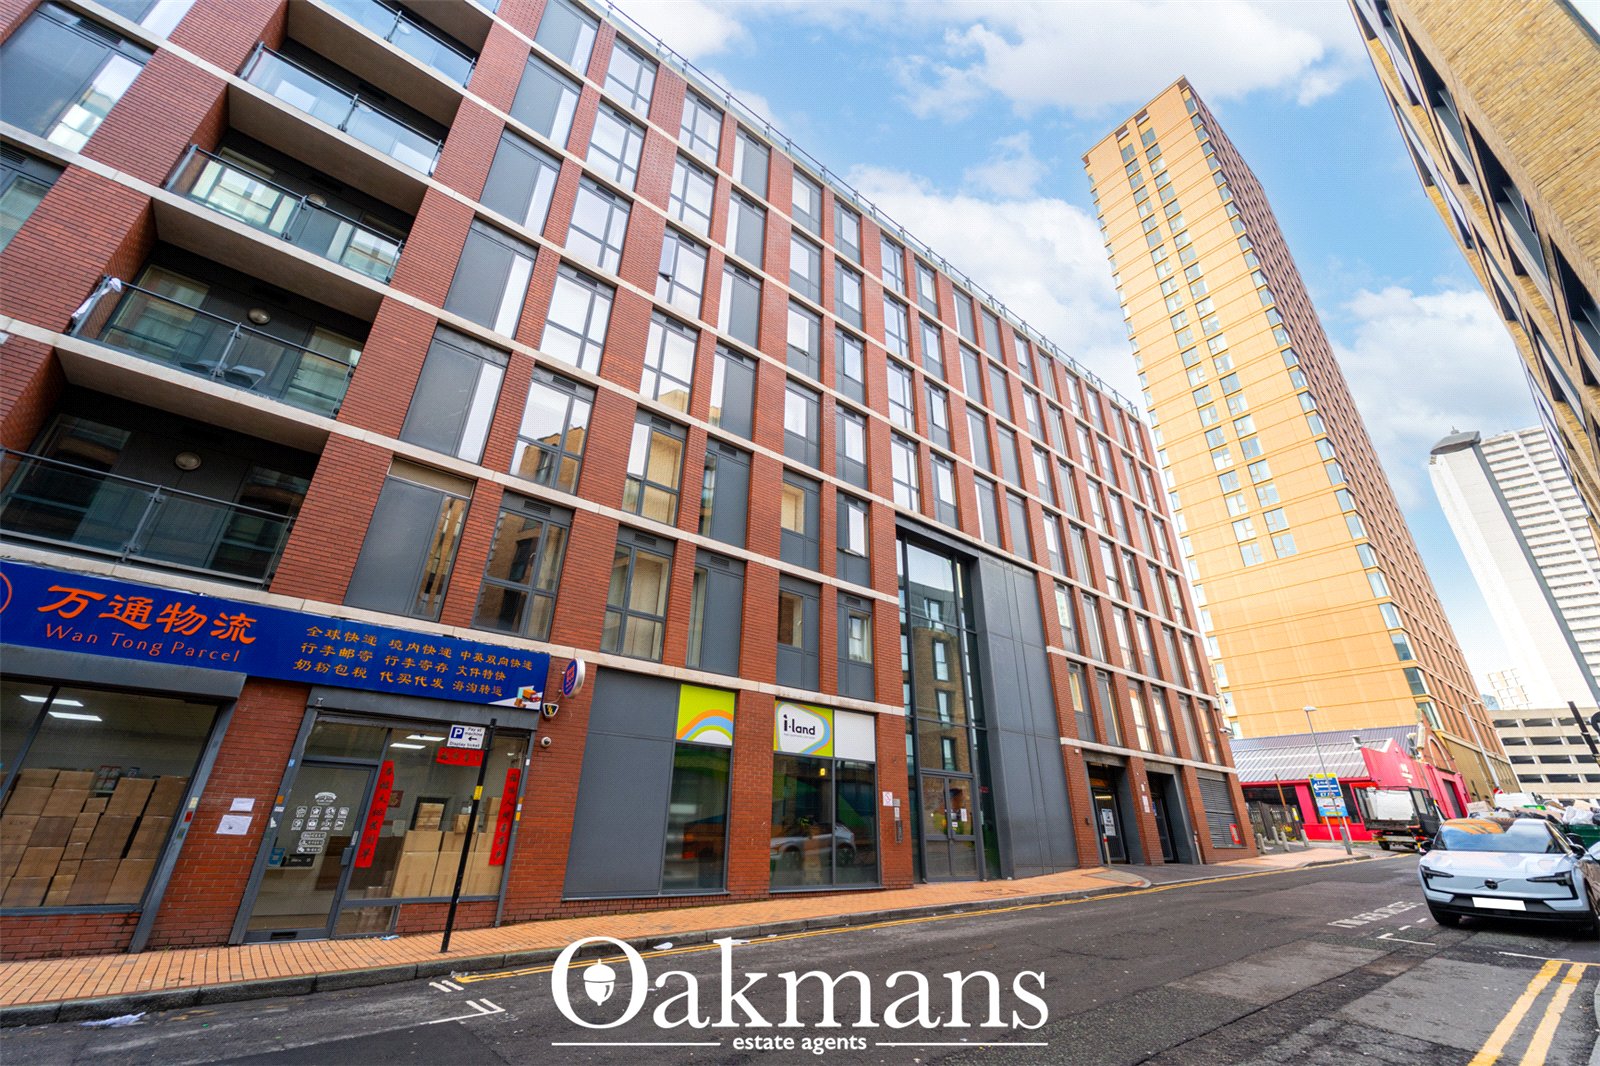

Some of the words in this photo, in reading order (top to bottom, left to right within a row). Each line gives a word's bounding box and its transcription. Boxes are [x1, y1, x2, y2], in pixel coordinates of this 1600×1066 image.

[37, 585, 257, 644] 万通物流
[45, 623, 97, 644] Wan
[111, 632, 163, 656] Tong
[171, 641, 240, 663] Parcel
[306, 625, 378, 647] 全球快递
[300, 642, 373, 662] 行李邮寄
[380, 671, 444, 689] 代买代发
[453, 728, 463, 738] P
